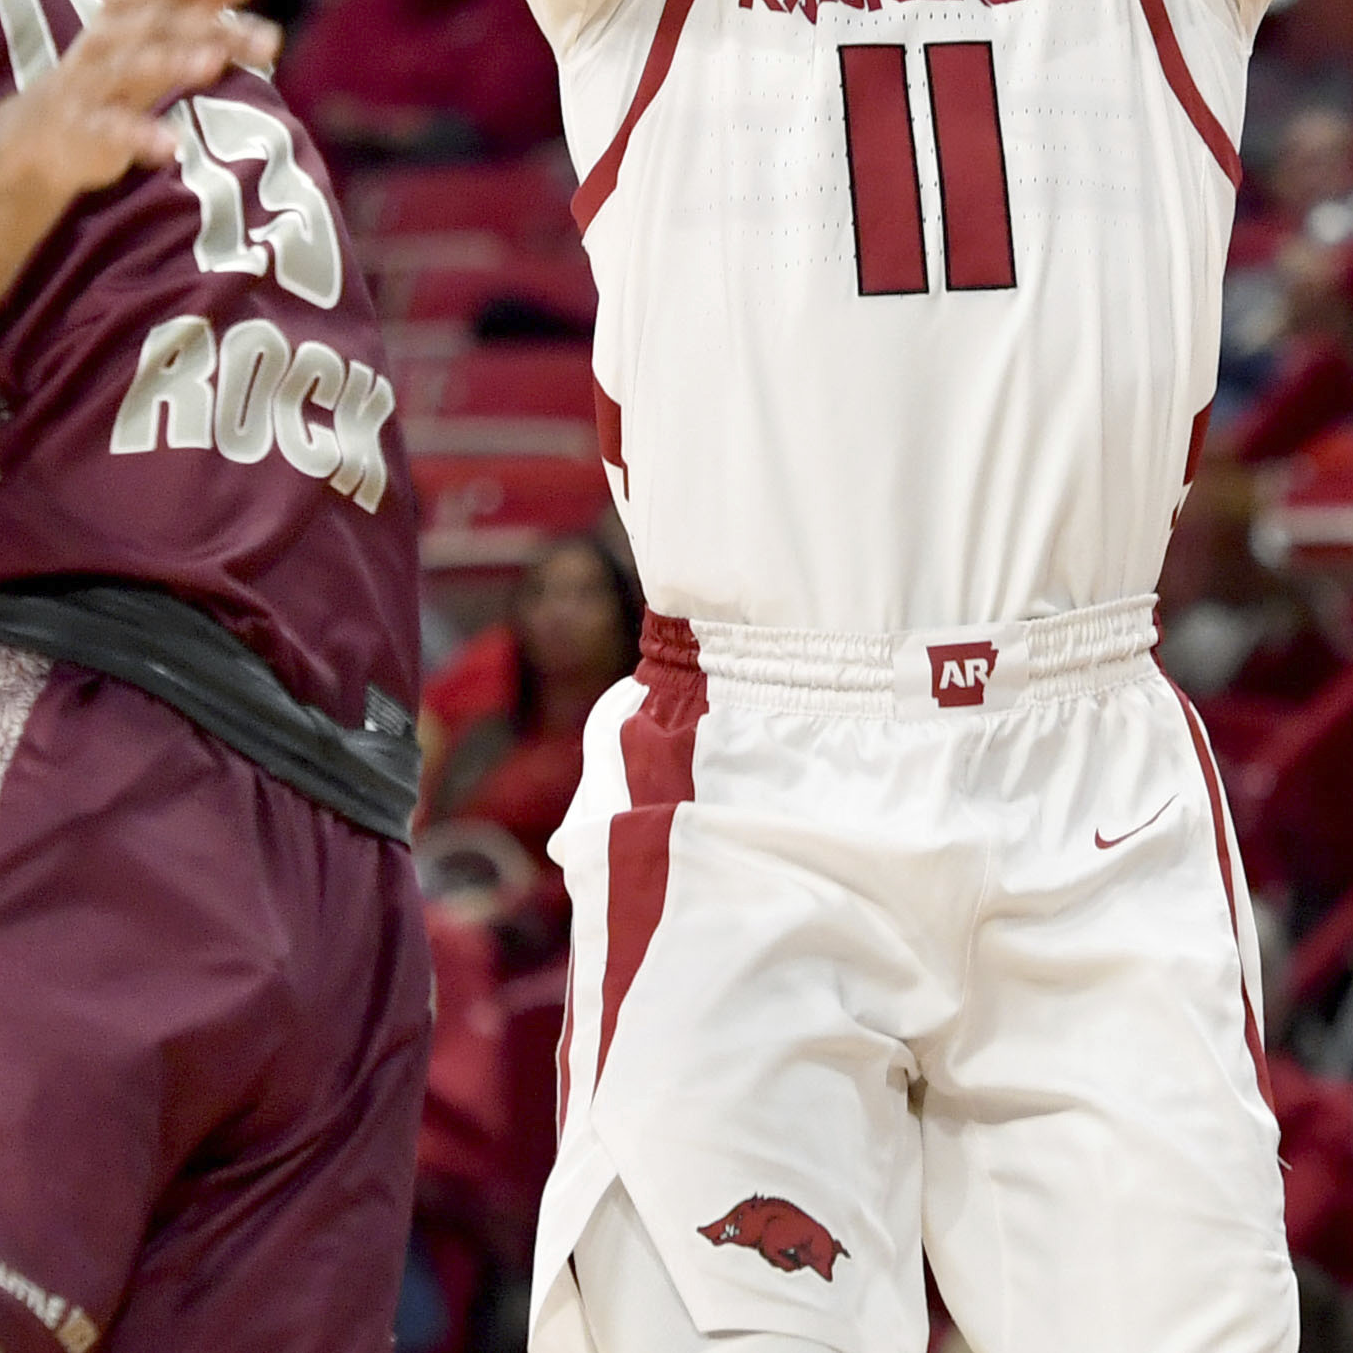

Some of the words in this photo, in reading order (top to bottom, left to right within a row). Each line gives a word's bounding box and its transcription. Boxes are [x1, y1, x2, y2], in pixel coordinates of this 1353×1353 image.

[167, 95, 342, 310] 13
[837, 40, 1018, 297] 11
[109, 315, 396, 514] ROCK
[939, 657, 992, 690] AR
